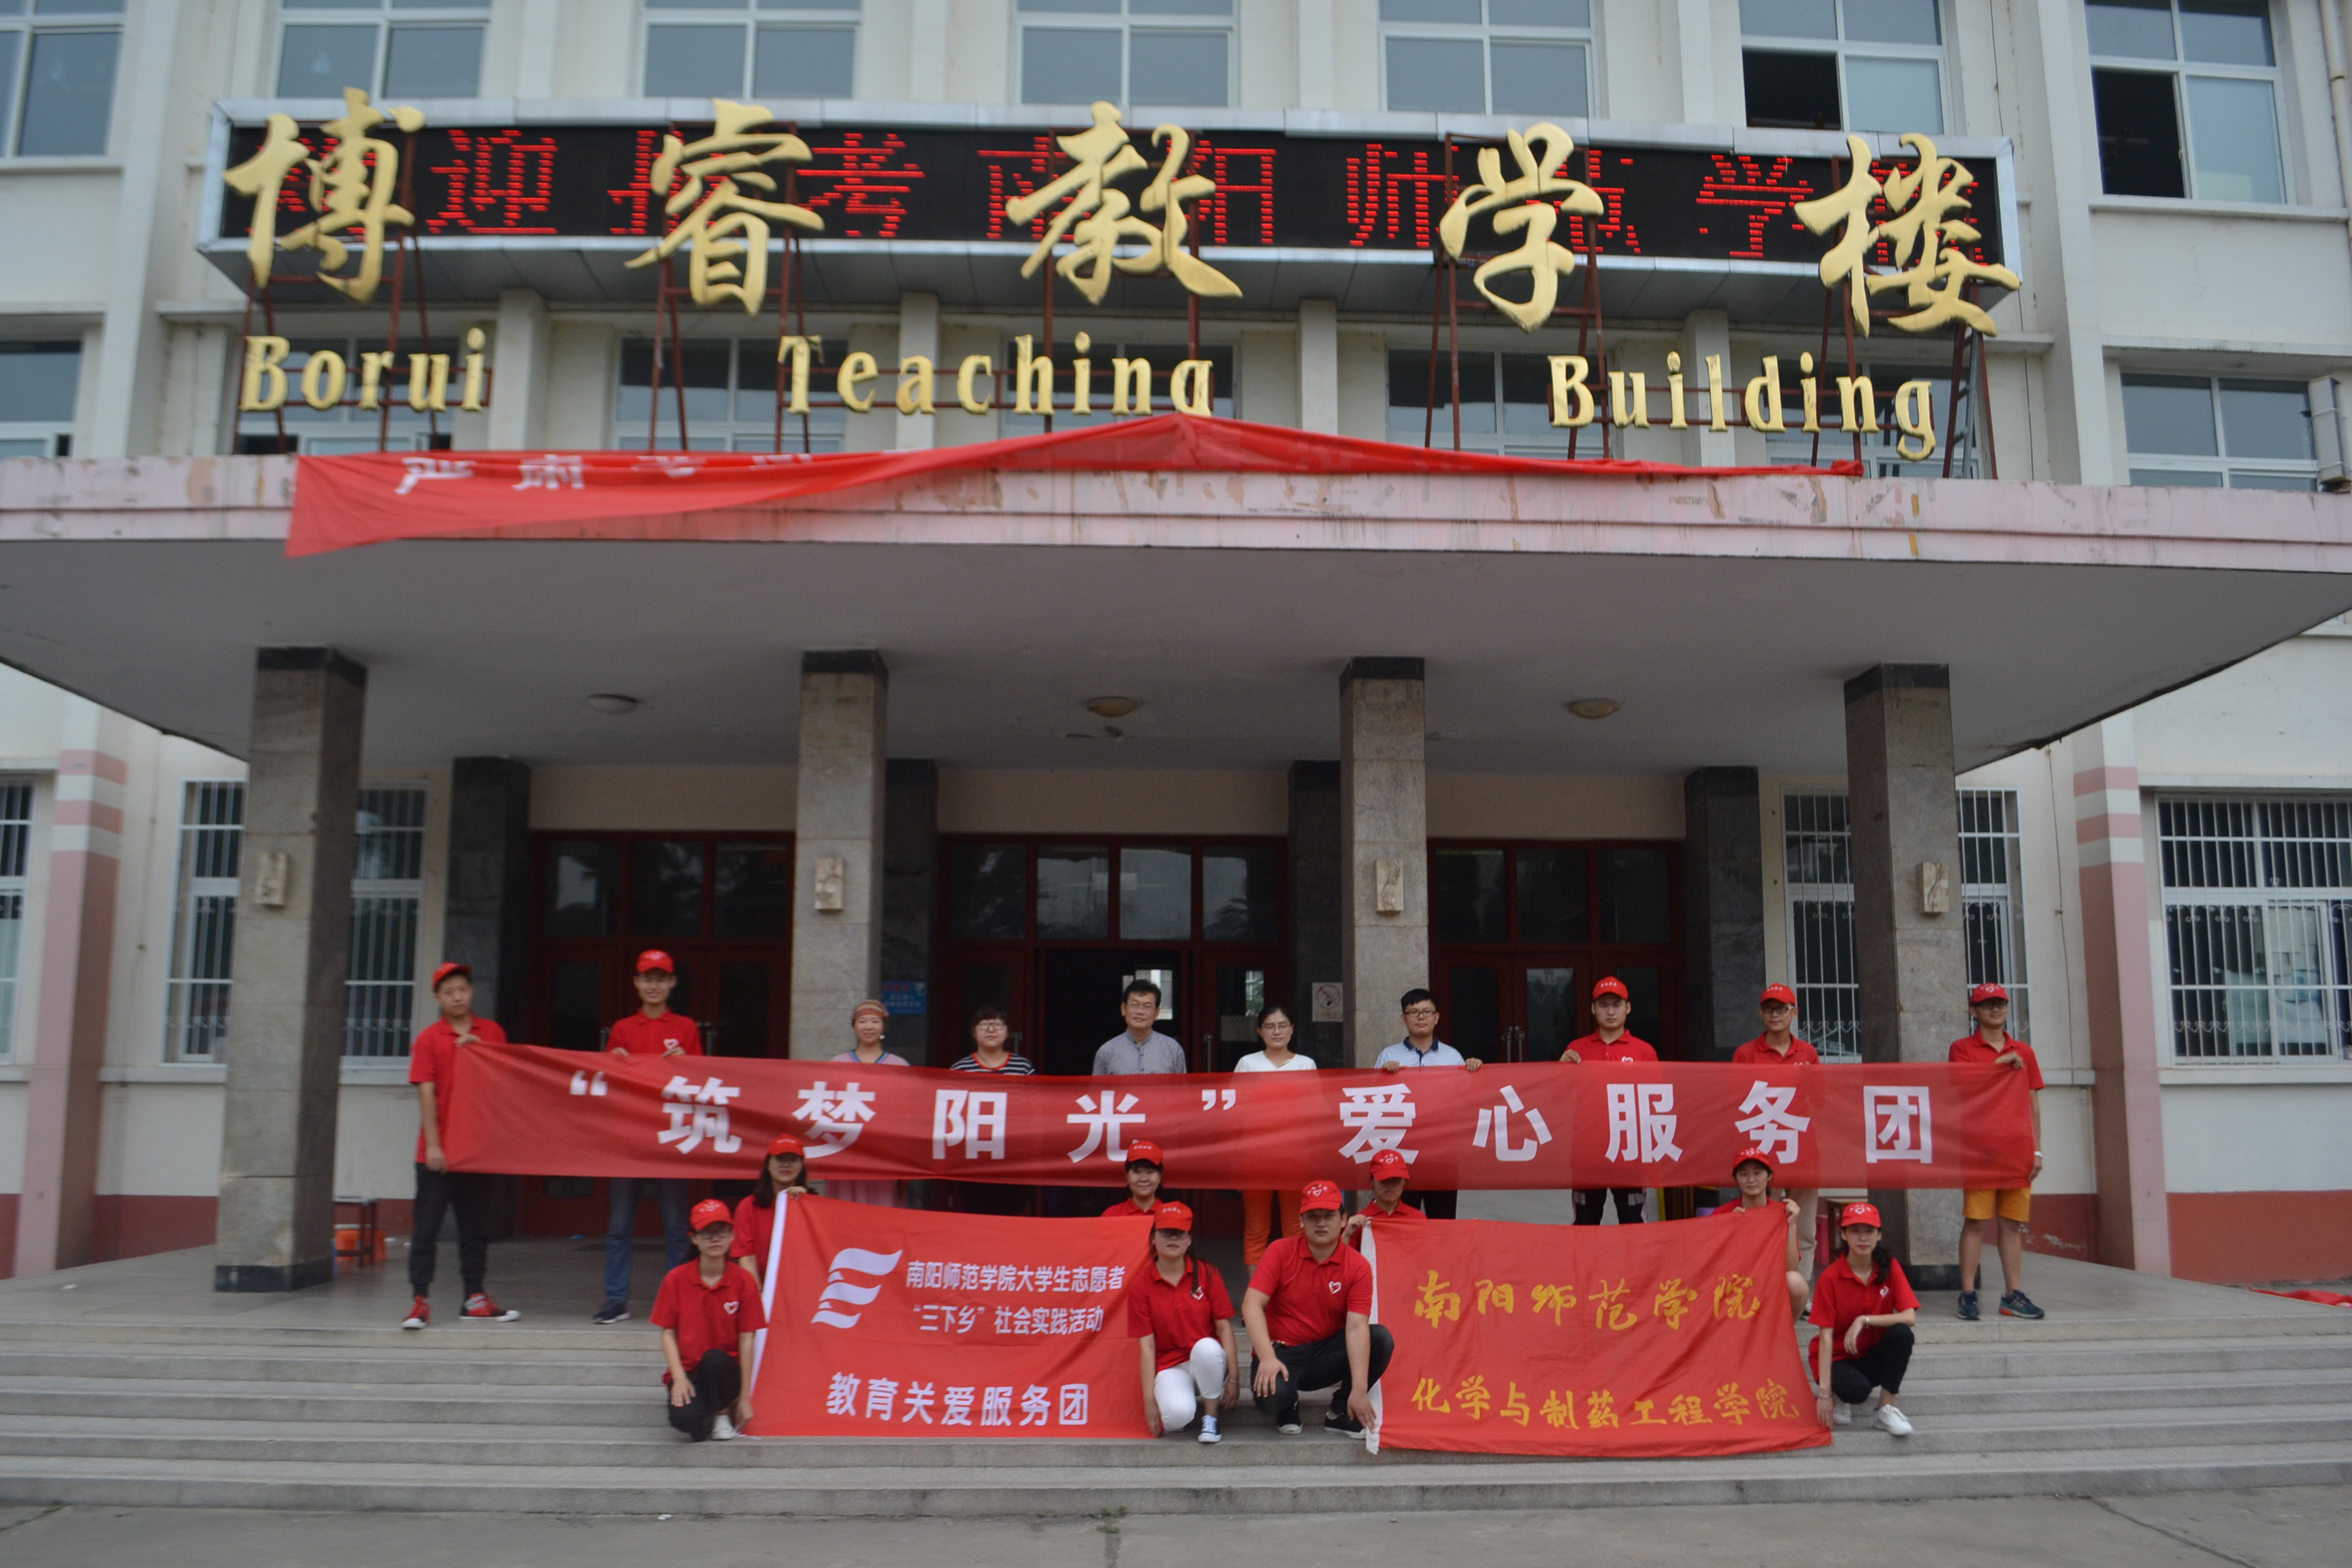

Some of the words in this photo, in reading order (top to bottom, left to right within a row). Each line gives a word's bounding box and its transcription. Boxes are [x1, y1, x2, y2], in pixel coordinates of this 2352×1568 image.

[224, 86, 2020, 340] 博睿教学楼
[241, 327, 485, 412] Borui
[778, 331, 1216, 417] Teaching
[1548, 350, 1937, 461] Building
[905, 1260, 1126, 1294] 南阳师范学院大学生志愿者
[1414, 1270, 1761, 1330] 南阳师范学院
[826, 1371, 1089, 1426] 教育关爱服务团
[1411, 1375, 1801, 1429] 化学与制药工程学院
